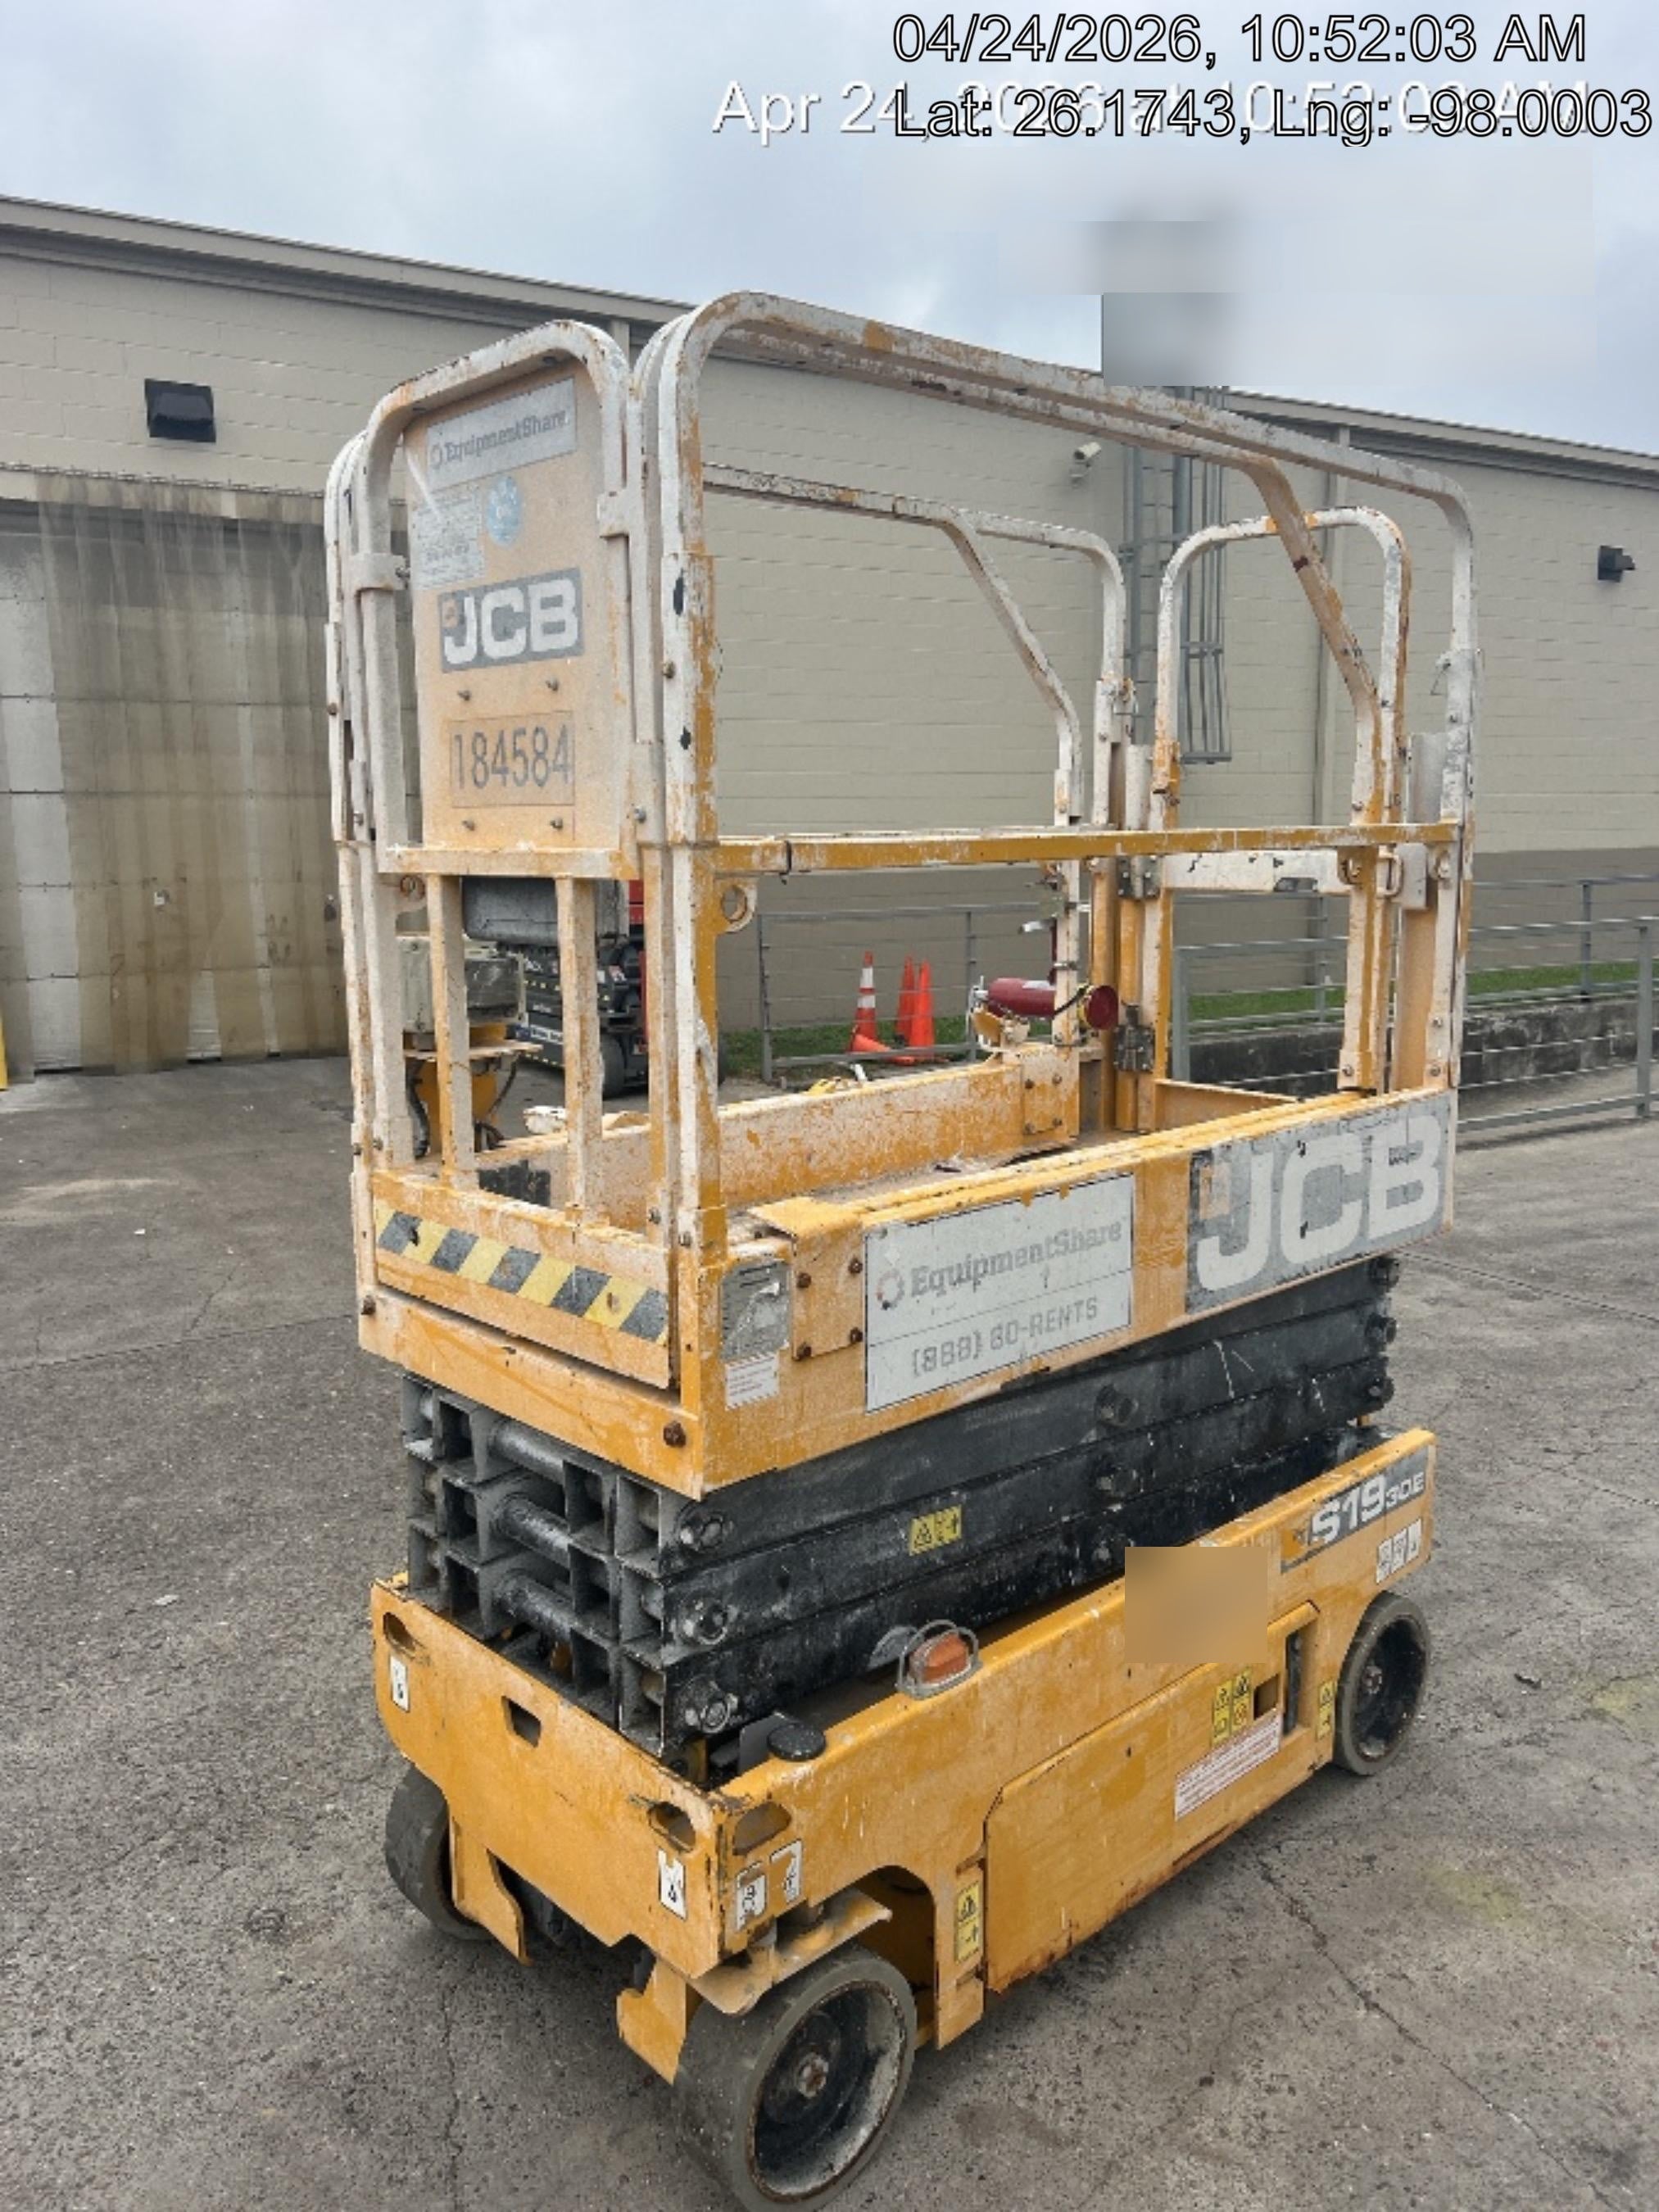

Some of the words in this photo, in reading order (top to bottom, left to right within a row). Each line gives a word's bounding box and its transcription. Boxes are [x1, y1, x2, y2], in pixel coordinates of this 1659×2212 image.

[443, 578, 578, 664] JCB
[454, 724, 571, 789] 184584
[1196, 1115, 1441, 1290] JCB
[911, 1221, 1122, 1298] EquipmentShare
